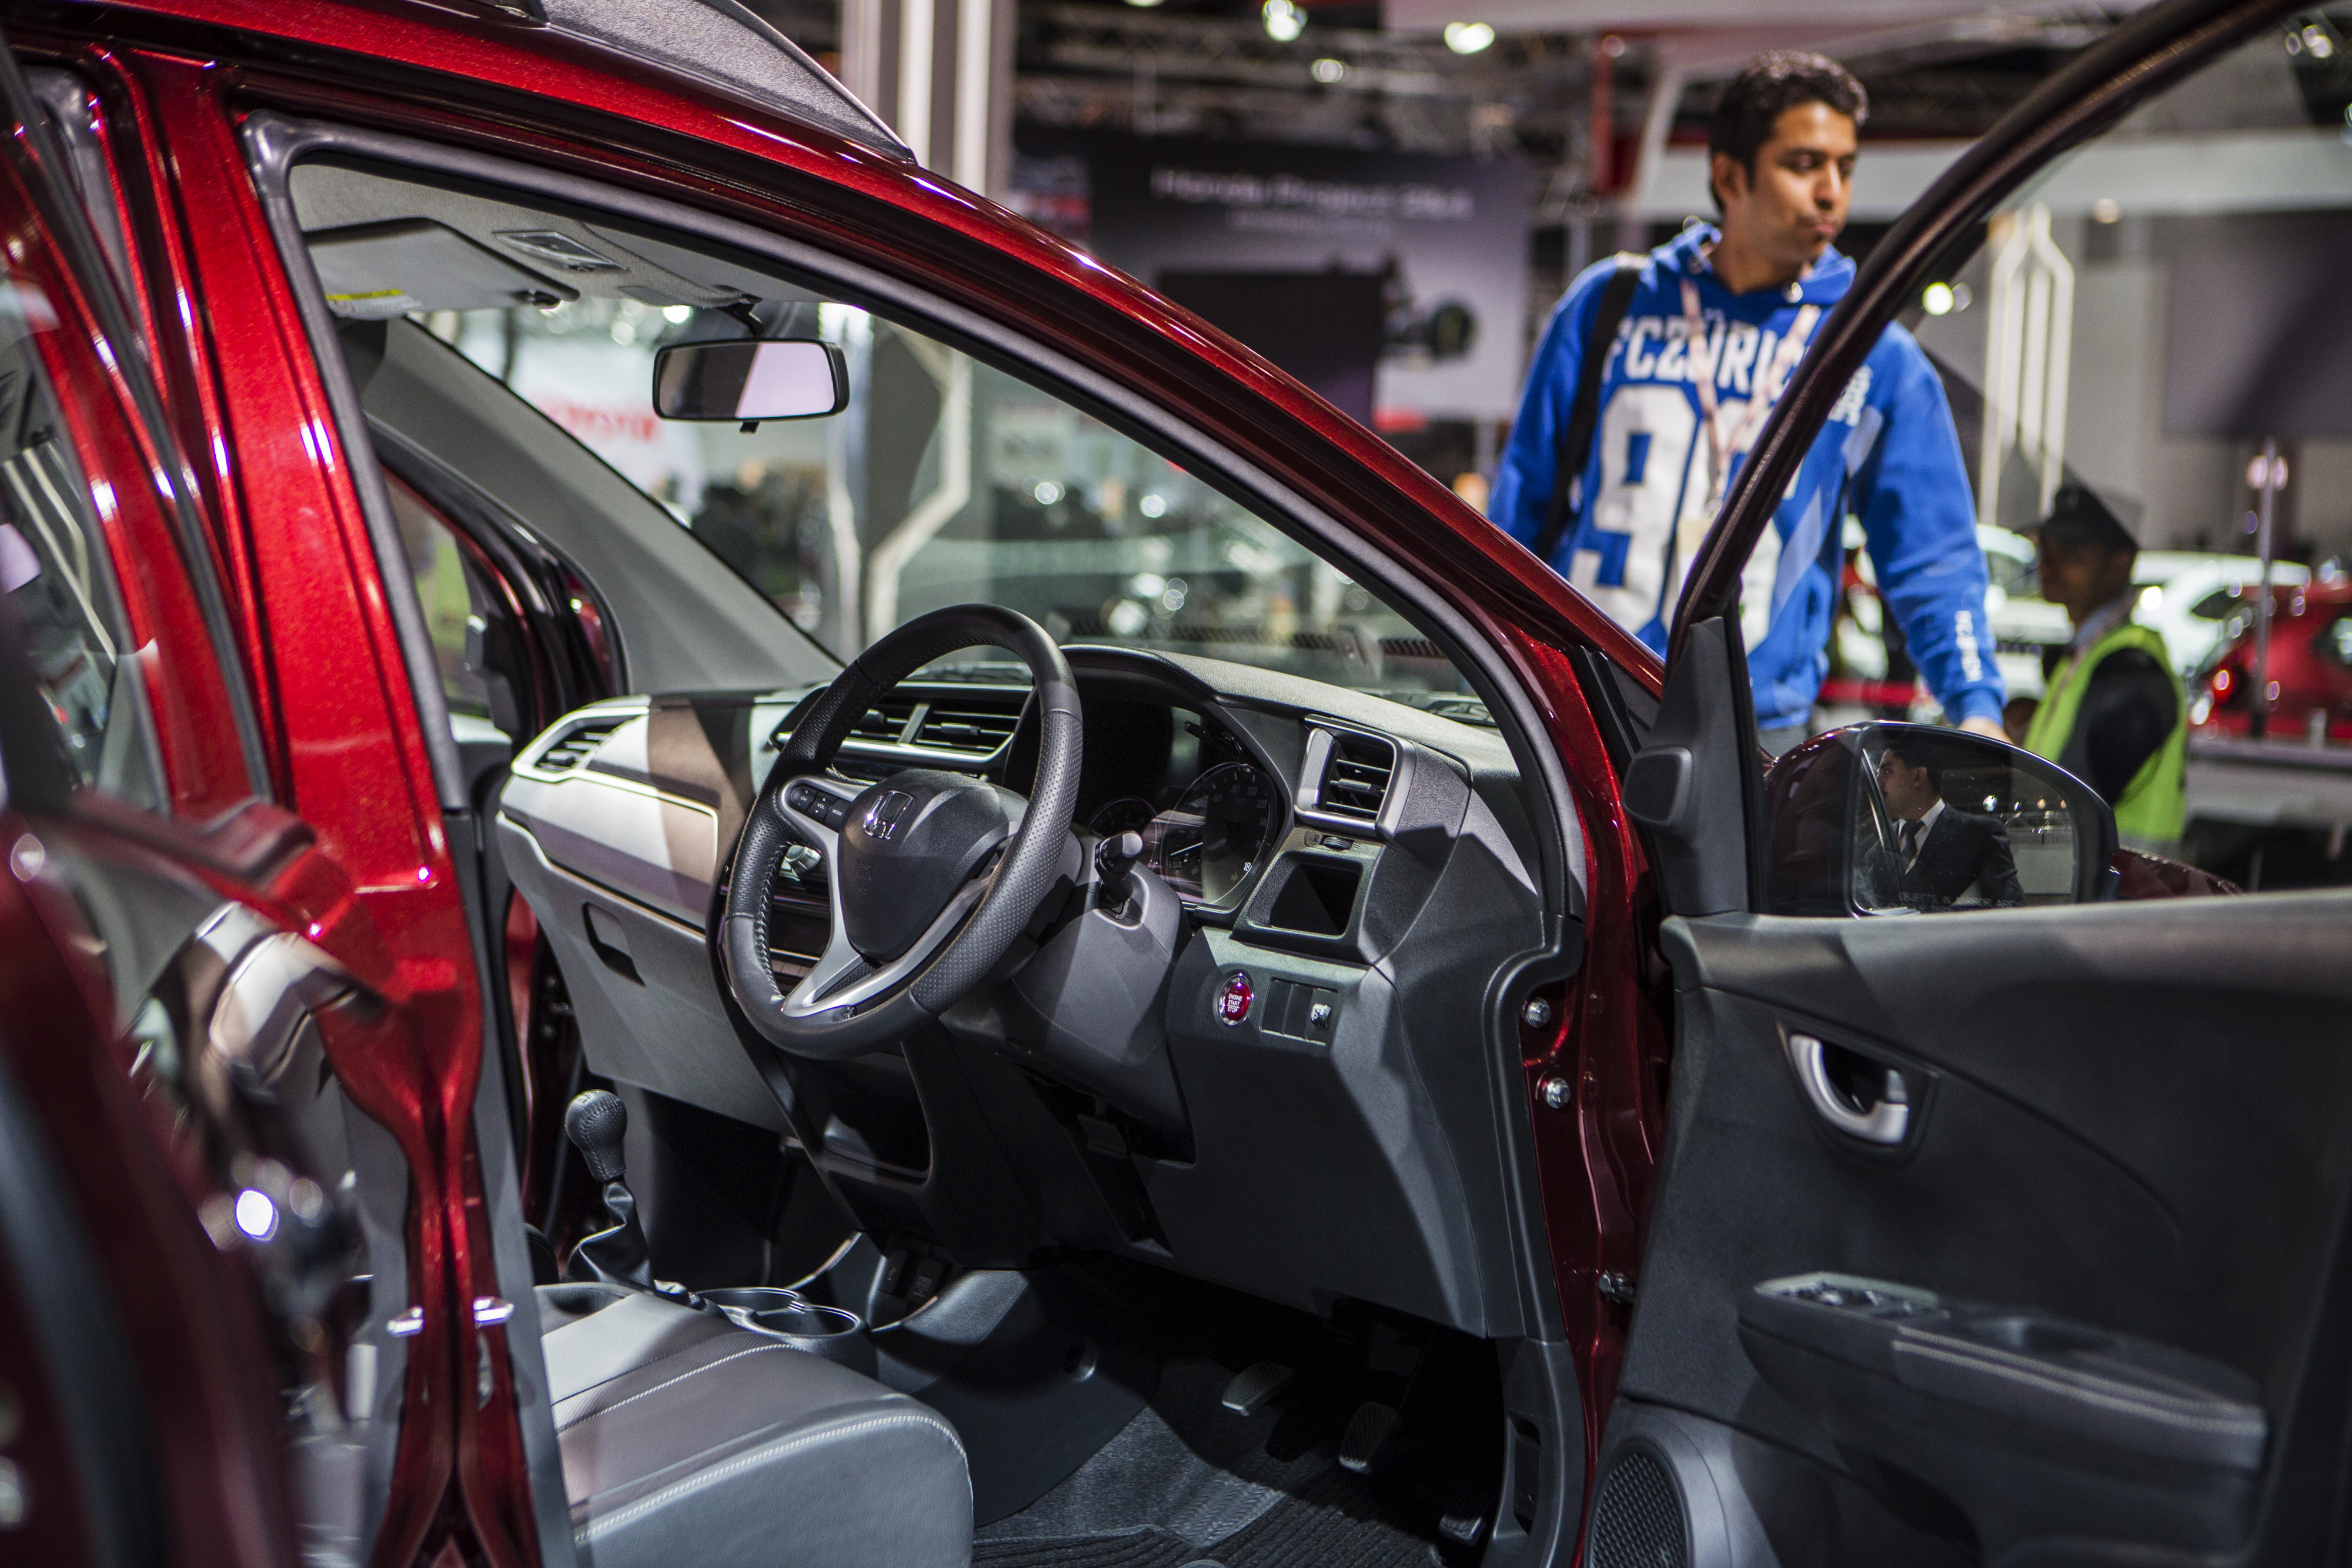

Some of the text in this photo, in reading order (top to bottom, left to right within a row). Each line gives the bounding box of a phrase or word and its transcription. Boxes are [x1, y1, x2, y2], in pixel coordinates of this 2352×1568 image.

[1247, 787, 1258, 795] 100
[1213, 794, 1222, 803] 60
[1257, 800, 1267, 809] 120
[1187, 830, 1197, 839] 20
[1243, 862, 1252, 872] 18
